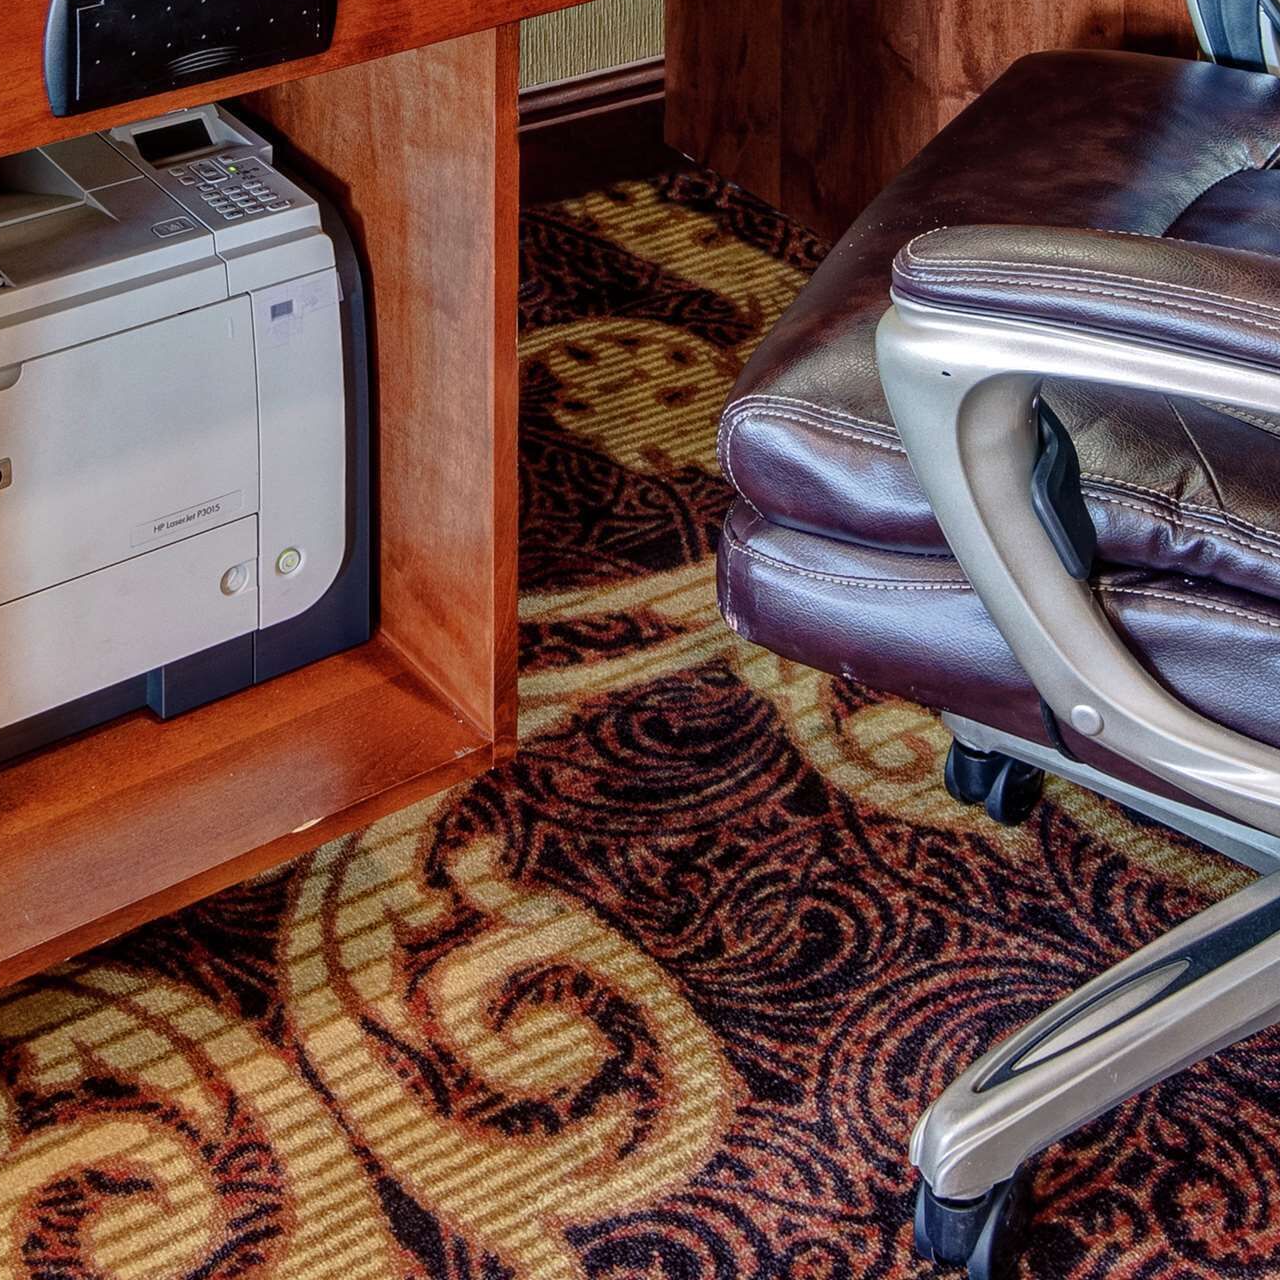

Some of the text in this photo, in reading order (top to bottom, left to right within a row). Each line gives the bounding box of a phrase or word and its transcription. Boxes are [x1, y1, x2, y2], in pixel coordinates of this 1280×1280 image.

[153, 503, 221, 534] HP LaserJet P3015
